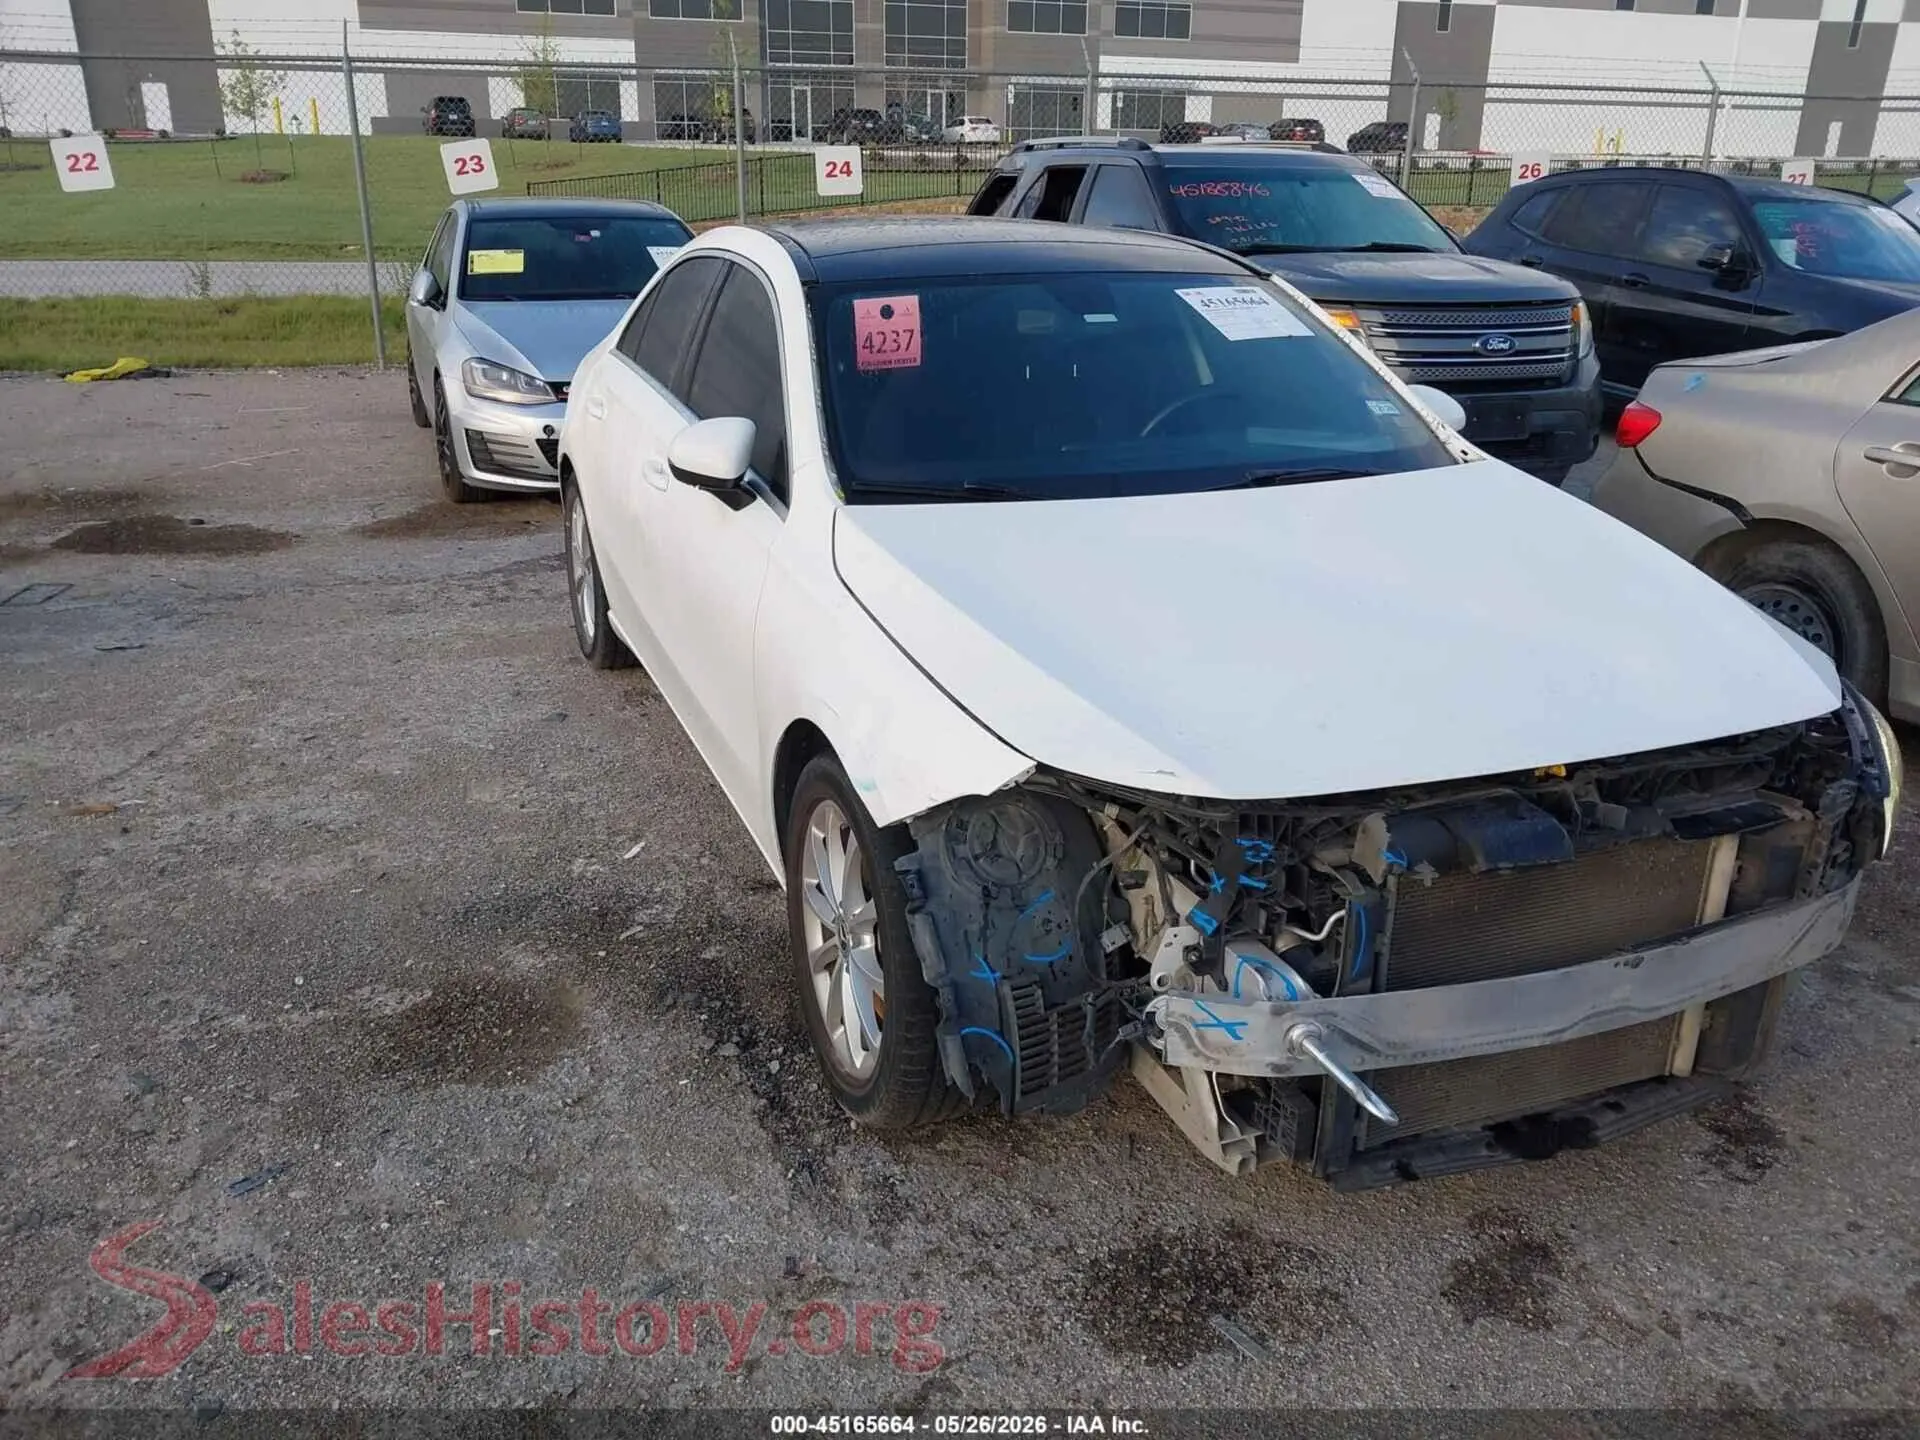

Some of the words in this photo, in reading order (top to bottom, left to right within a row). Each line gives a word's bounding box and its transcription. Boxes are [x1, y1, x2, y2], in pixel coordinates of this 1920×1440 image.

[65, 152, 99, 172] 22
[454, 155, 484, 176] 23
[825, 160, 853, 178] 24
[1518, 163, 1542, 179] 26
[1788, 173, 1807, 185] 27
[861, 329, 914, 354] 4237
[1487, 337, 1511, 350] Ford
